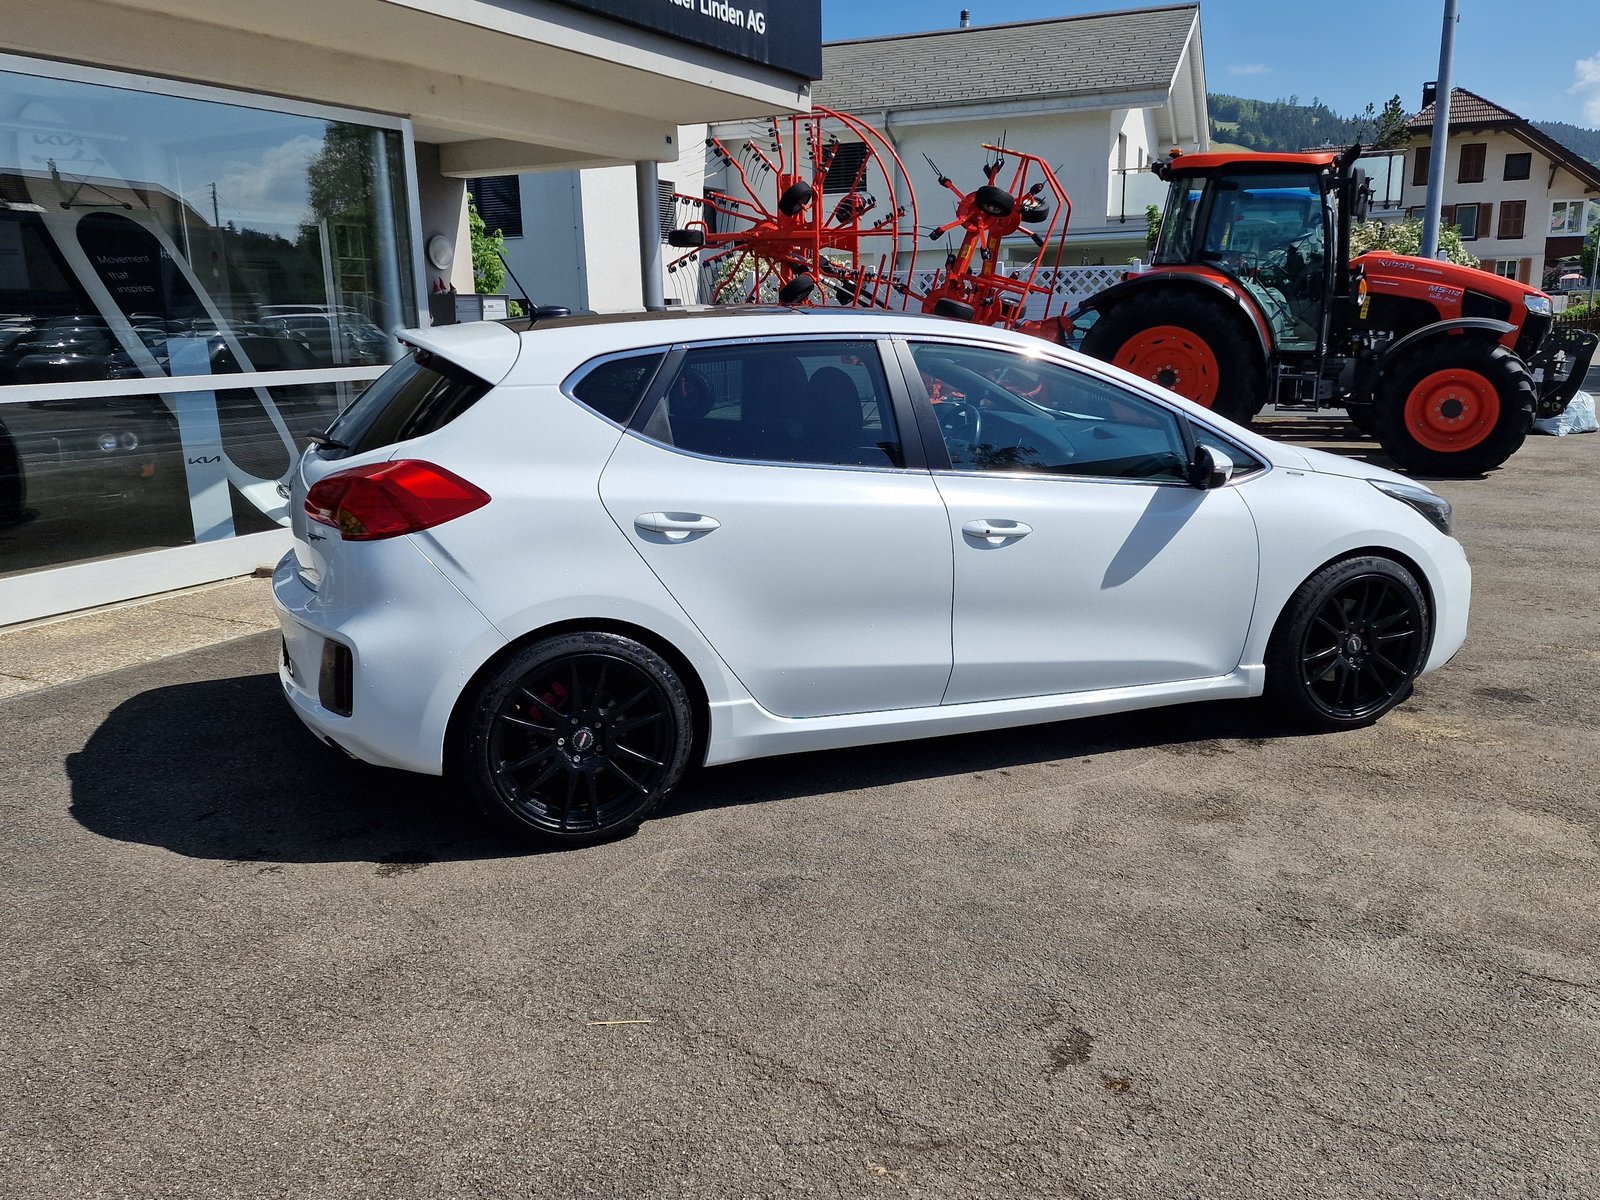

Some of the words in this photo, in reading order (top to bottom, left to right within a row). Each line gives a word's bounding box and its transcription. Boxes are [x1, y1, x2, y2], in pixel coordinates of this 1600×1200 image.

[700, 0, 744, 28] Linden
[747, 9, 766, 35] AG
[96, 255, 150, 264] Movement
[107, 271, 129, 280] that
[116, 284, 156, 294] inspires
